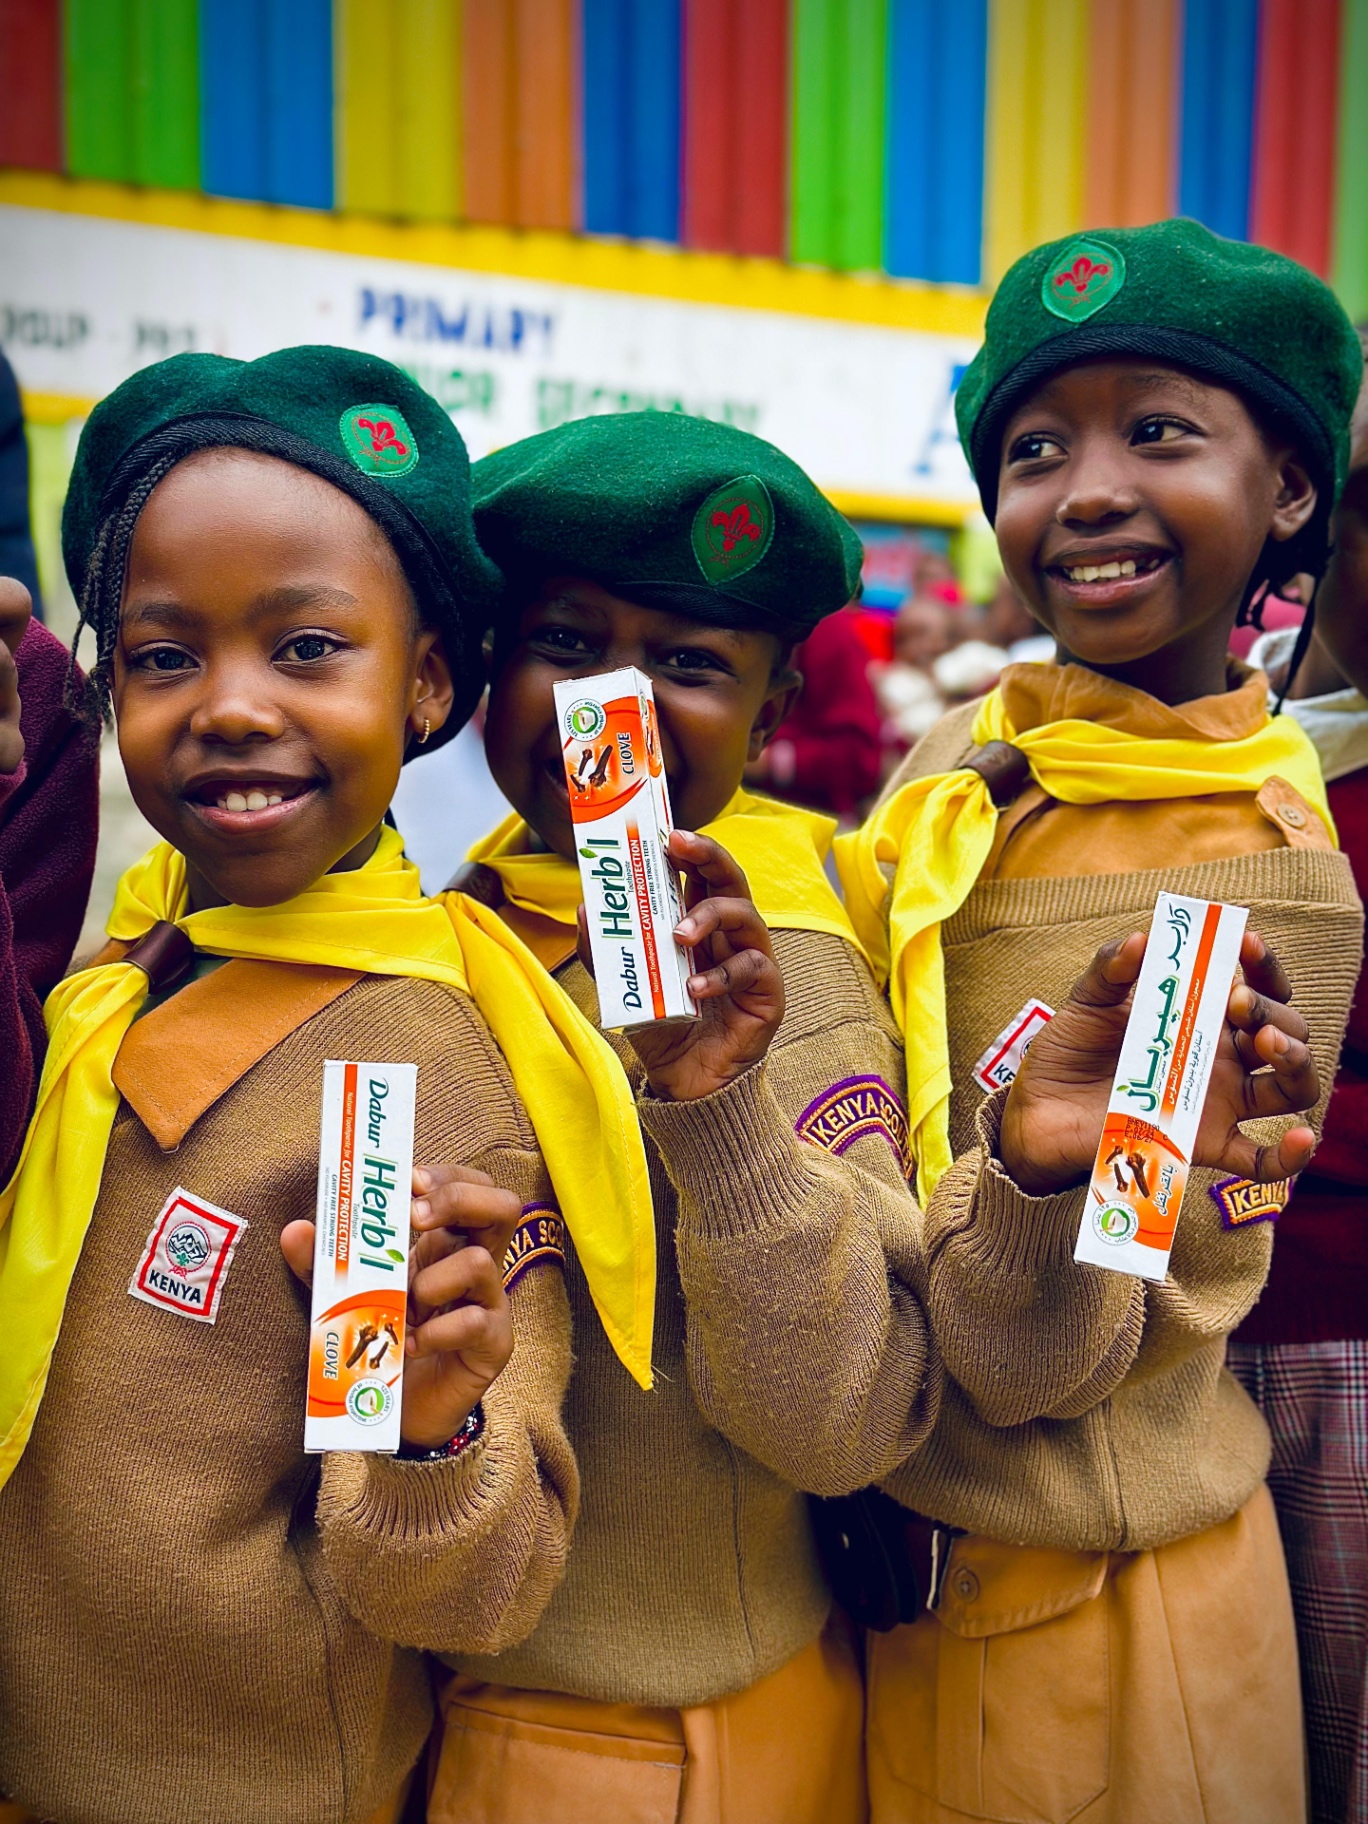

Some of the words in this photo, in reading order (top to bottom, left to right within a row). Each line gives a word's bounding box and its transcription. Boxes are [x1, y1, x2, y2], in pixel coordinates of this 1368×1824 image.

[360, 284, 556, 356] PRIMARY
[618, 732, 635, 774] CLOVE
[625, 861, 634, 893] Toothpaste
[630, 839, 646, 896] PROTECTION
[645, 858, 653, 880] STRONG
[639, 898, 652, 930] CAVITY
[647, 940, 657, 970] Toothpaste
[620, 946, 642, 1012] Dabur
[1127, 976, 1178, 1112] هيربال
[345, 1092, 354, 1114] Natural
[368, 1077, 389, 1148] Dabur
[811, 1092, 880, 1143] KENYA
[343, 1115, 353, 1148] Toothpaste
[341, 1148, 351, 1158] for
[340, 1159, 352, 1196] CAVITY
[1152, 1164, 1178, 1215] بالقرنفل
[336, 1196, 350, 1261] PROTECTION
[148, 1269, 201, 1304] KENYA
[324, 1331, 340, 1379] CLOVE
